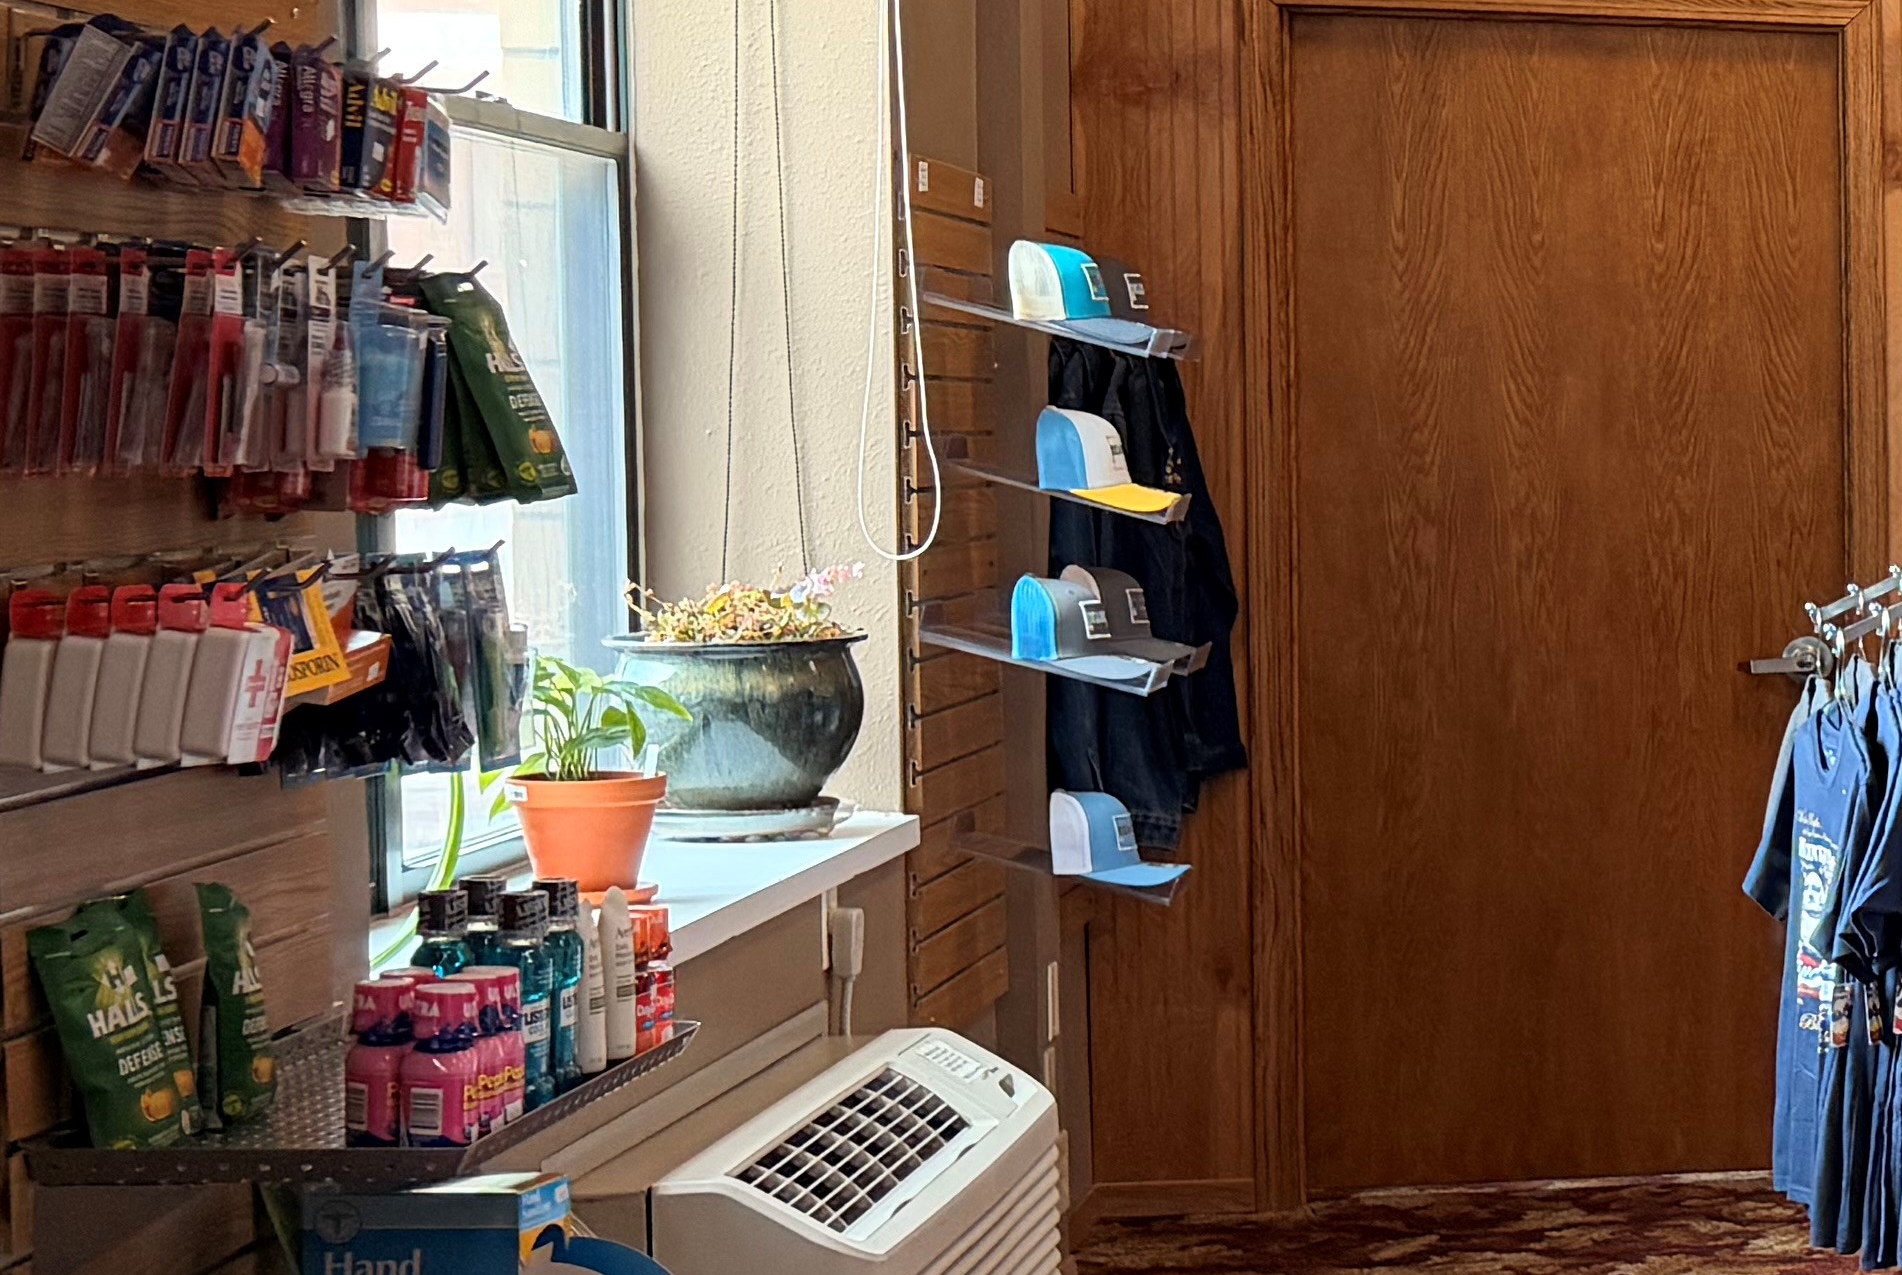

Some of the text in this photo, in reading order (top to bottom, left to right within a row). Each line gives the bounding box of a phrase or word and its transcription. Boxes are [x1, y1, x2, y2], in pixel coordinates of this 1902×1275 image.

[299, 65, 317, 114] Allegra
[344, 79, 366, 129] Advil
[86, 991, 155, 1041] HALLS
[117, 1040, 165, 1076] DEFENSE
